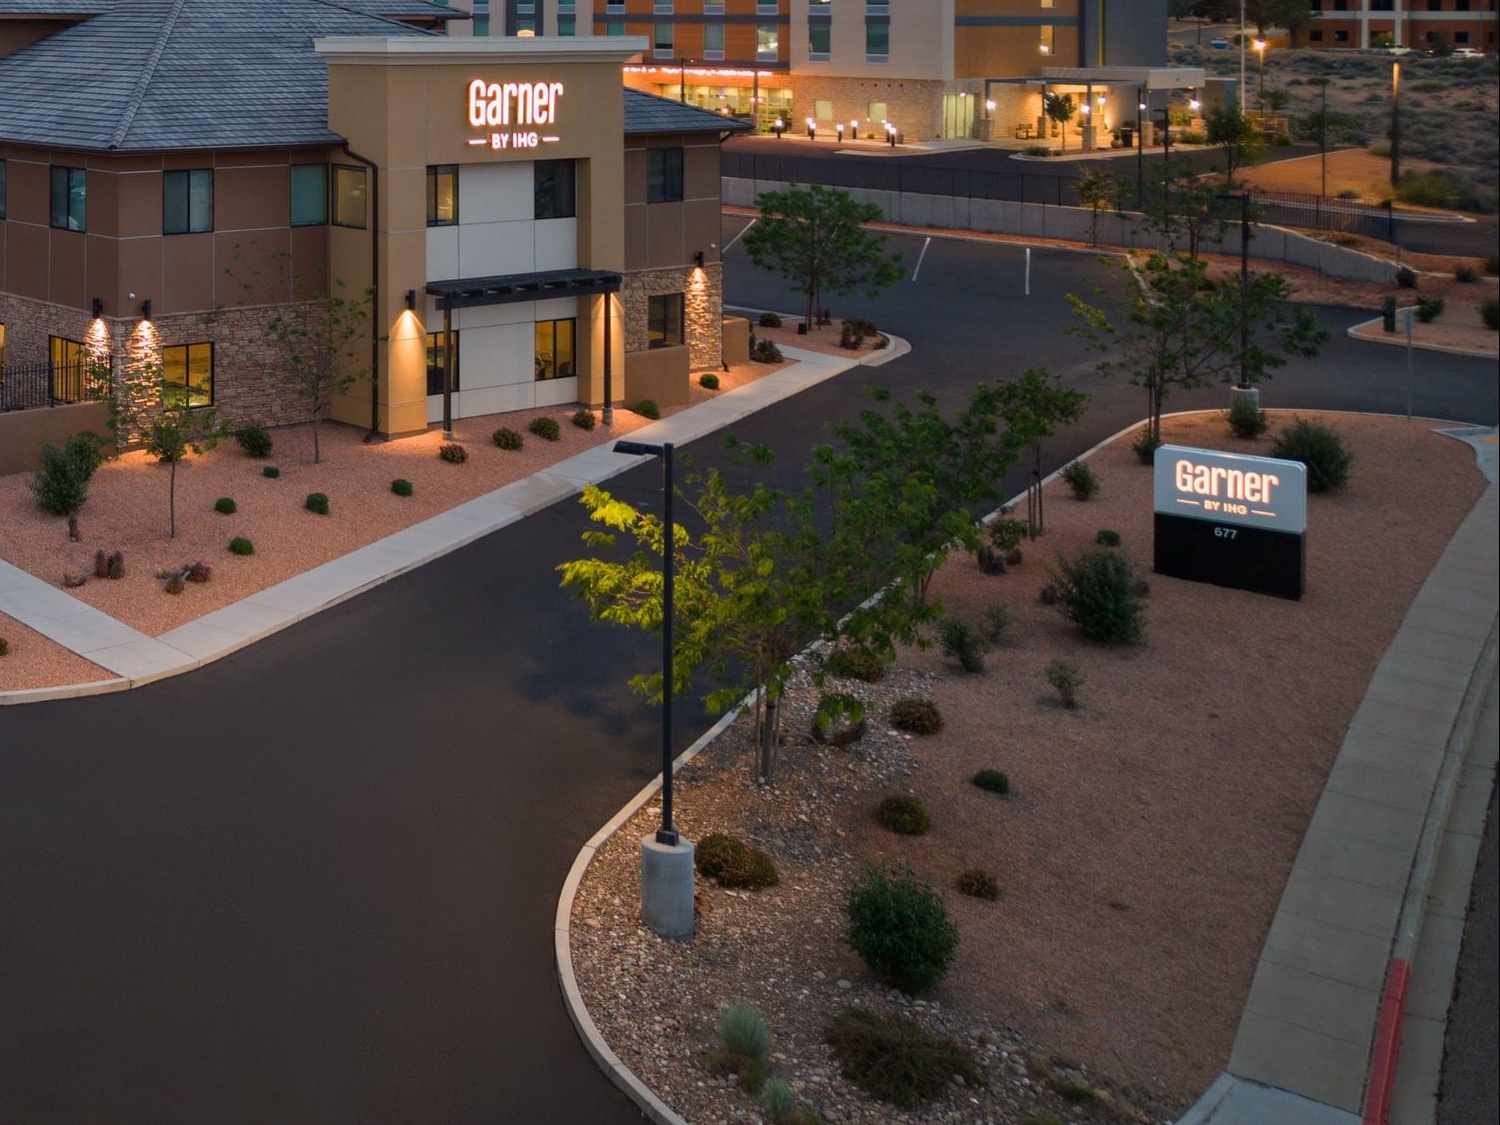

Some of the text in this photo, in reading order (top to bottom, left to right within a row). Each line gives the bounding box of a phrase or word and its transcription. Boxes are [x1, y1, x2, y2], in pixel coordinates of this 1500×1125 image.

[469, 79, 563, 126] Garner
[491, 132, 538, 149] BY IHG
[1175, 459, 1279, 504] Garner
[1204, 500, 1220, 511] BY
[1214, 527, 1238, 539] 677
